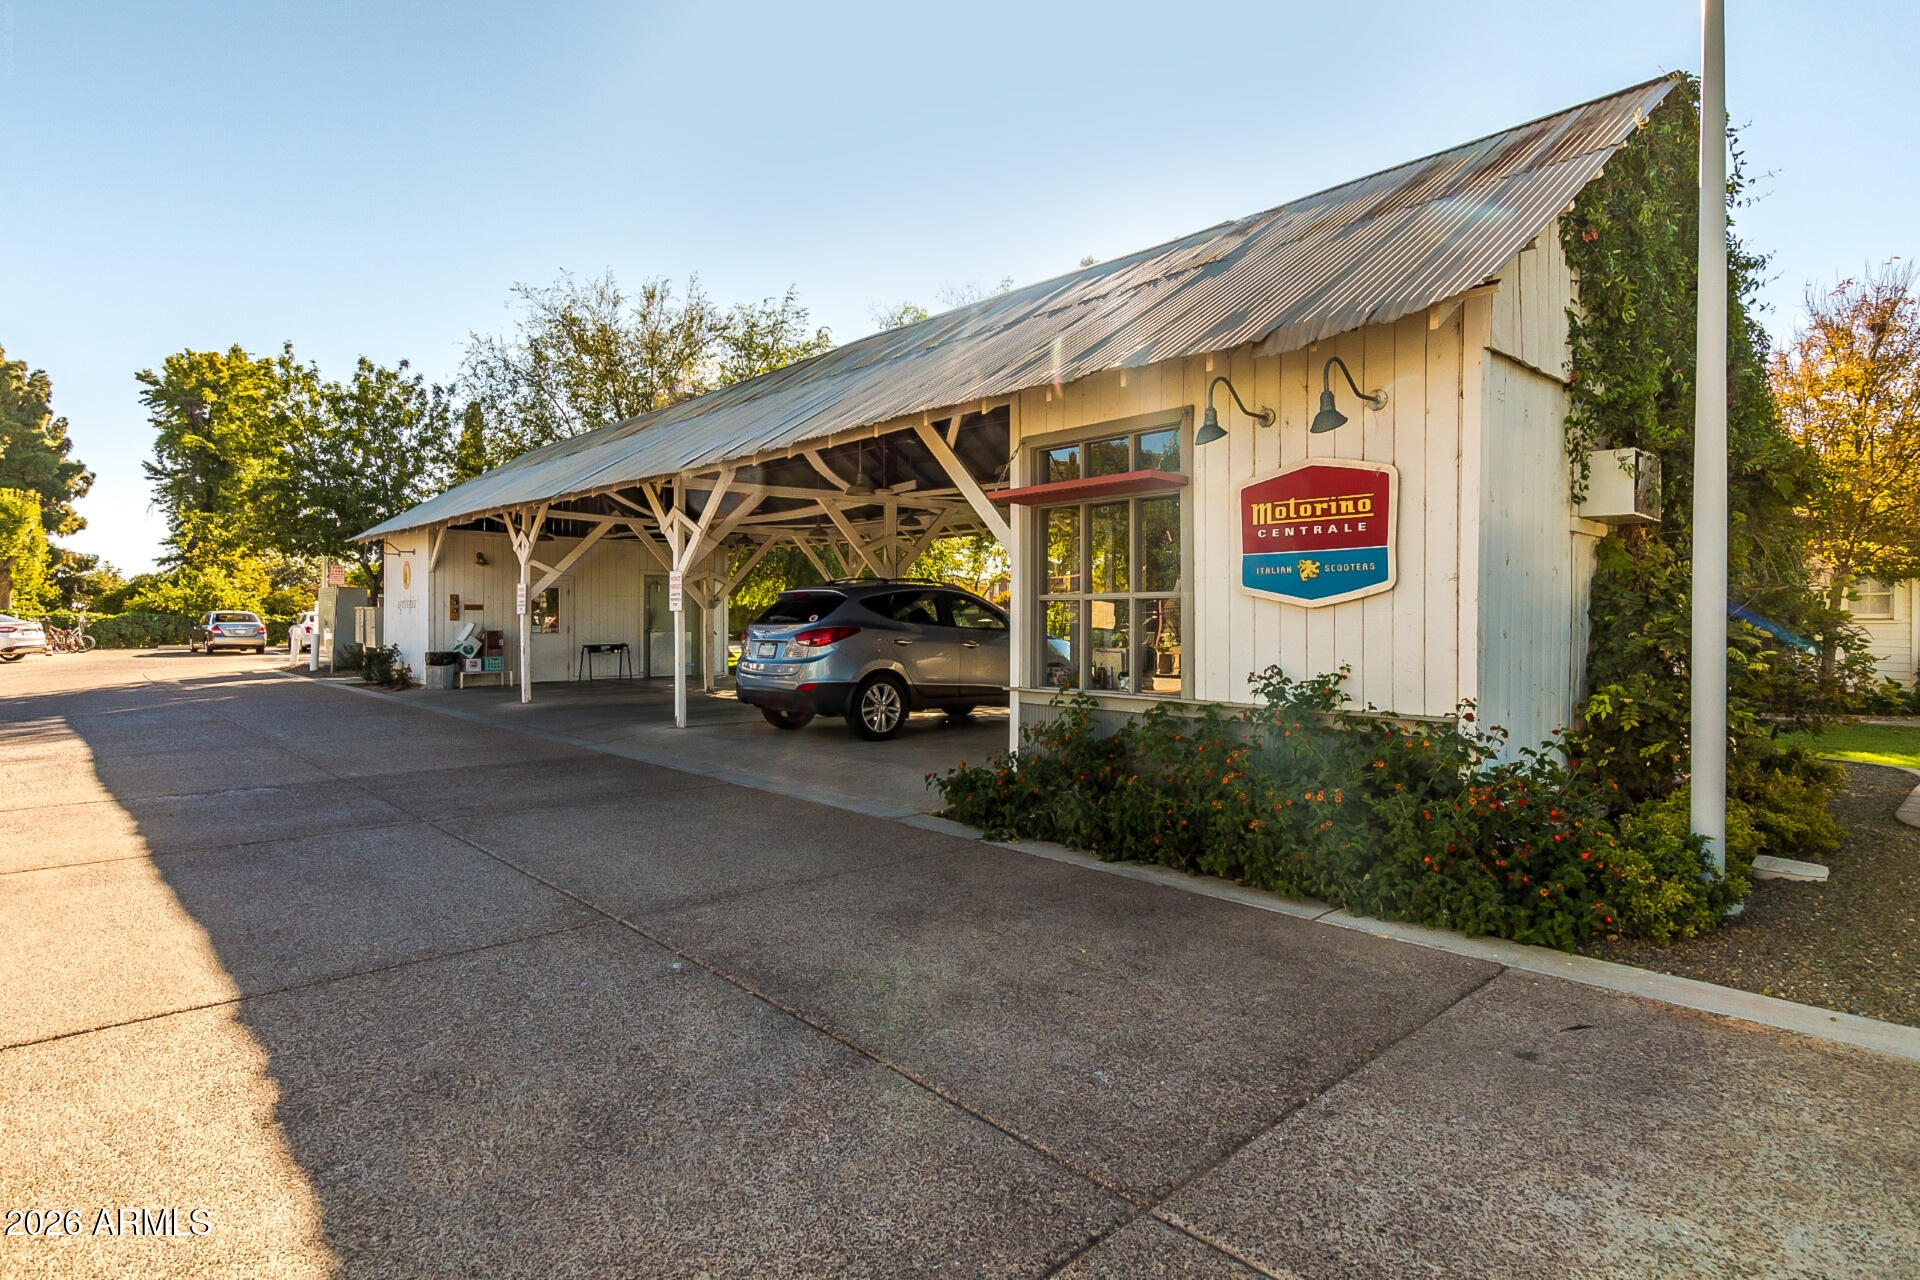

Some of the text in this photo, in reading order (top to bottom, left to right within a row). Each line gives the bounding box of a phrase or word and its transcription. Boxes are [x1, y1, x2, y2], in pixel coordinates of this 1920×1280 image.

[1251, 494, 1374, 526] Motorino
[1257, 522, 1367, 538] CENTRALE
[1256, 562, 1376, 575] ITALIAN SCOOTERS
